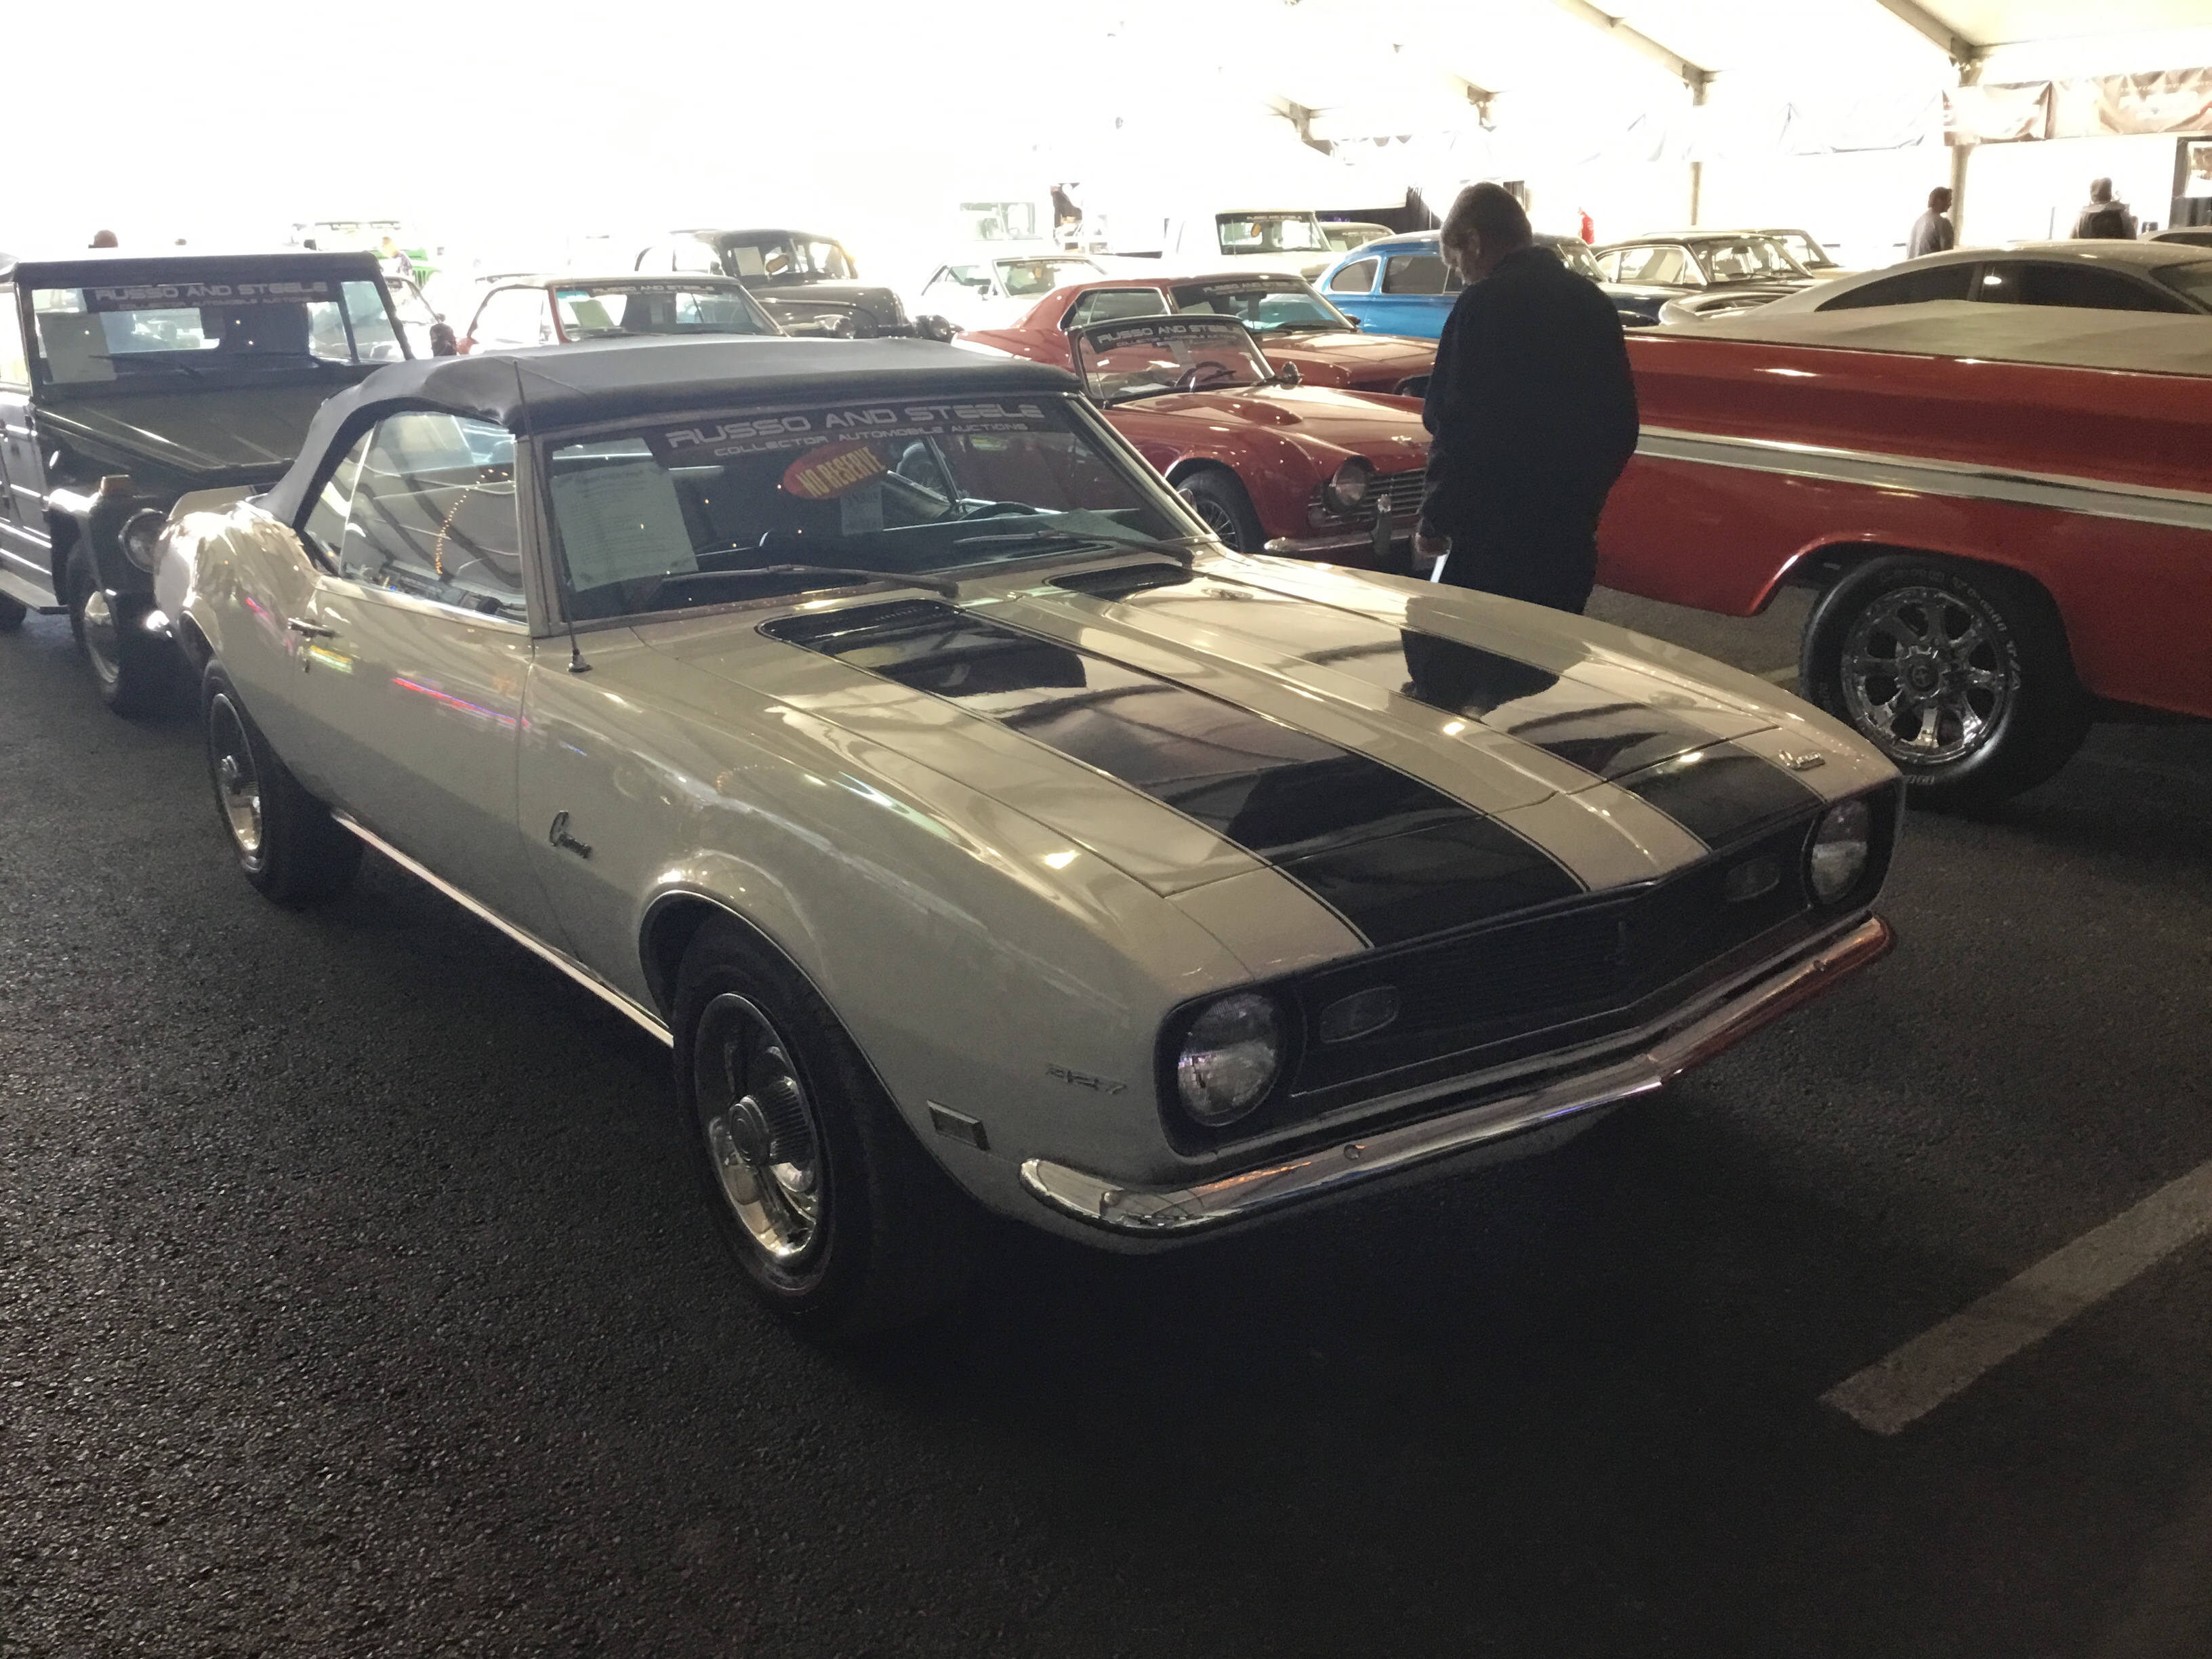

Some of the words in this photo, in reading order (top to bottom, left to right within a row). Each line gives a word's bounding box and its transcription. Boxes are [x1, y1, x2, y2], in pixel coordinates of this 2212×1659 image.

[96, 287, 179, 301] RUSSO
[186, 285, 232, 297] AND
[237, 281, 328, 295] STEELE
[1097, 327, 1153, 344] RUSSO
[1158, 325, 1187, 334] AND
[1189, 324, 1243, 334] STEELE
[665, 415, 812, 449] RUSSO
[825, 409, 897, 428] AND
[904, 403, 1045, 422] STEELE
[714, 435, 828, 457] COLLECTOR
[838, 426, 944, 442] AUTOMOBILE
[951, 422, 1028, 433] AUCTIONS
[795, 468, 830, 498] NO
[816, 446, 886, 489] RESERVE
[1044, 1063, 1128, 1096] 327
